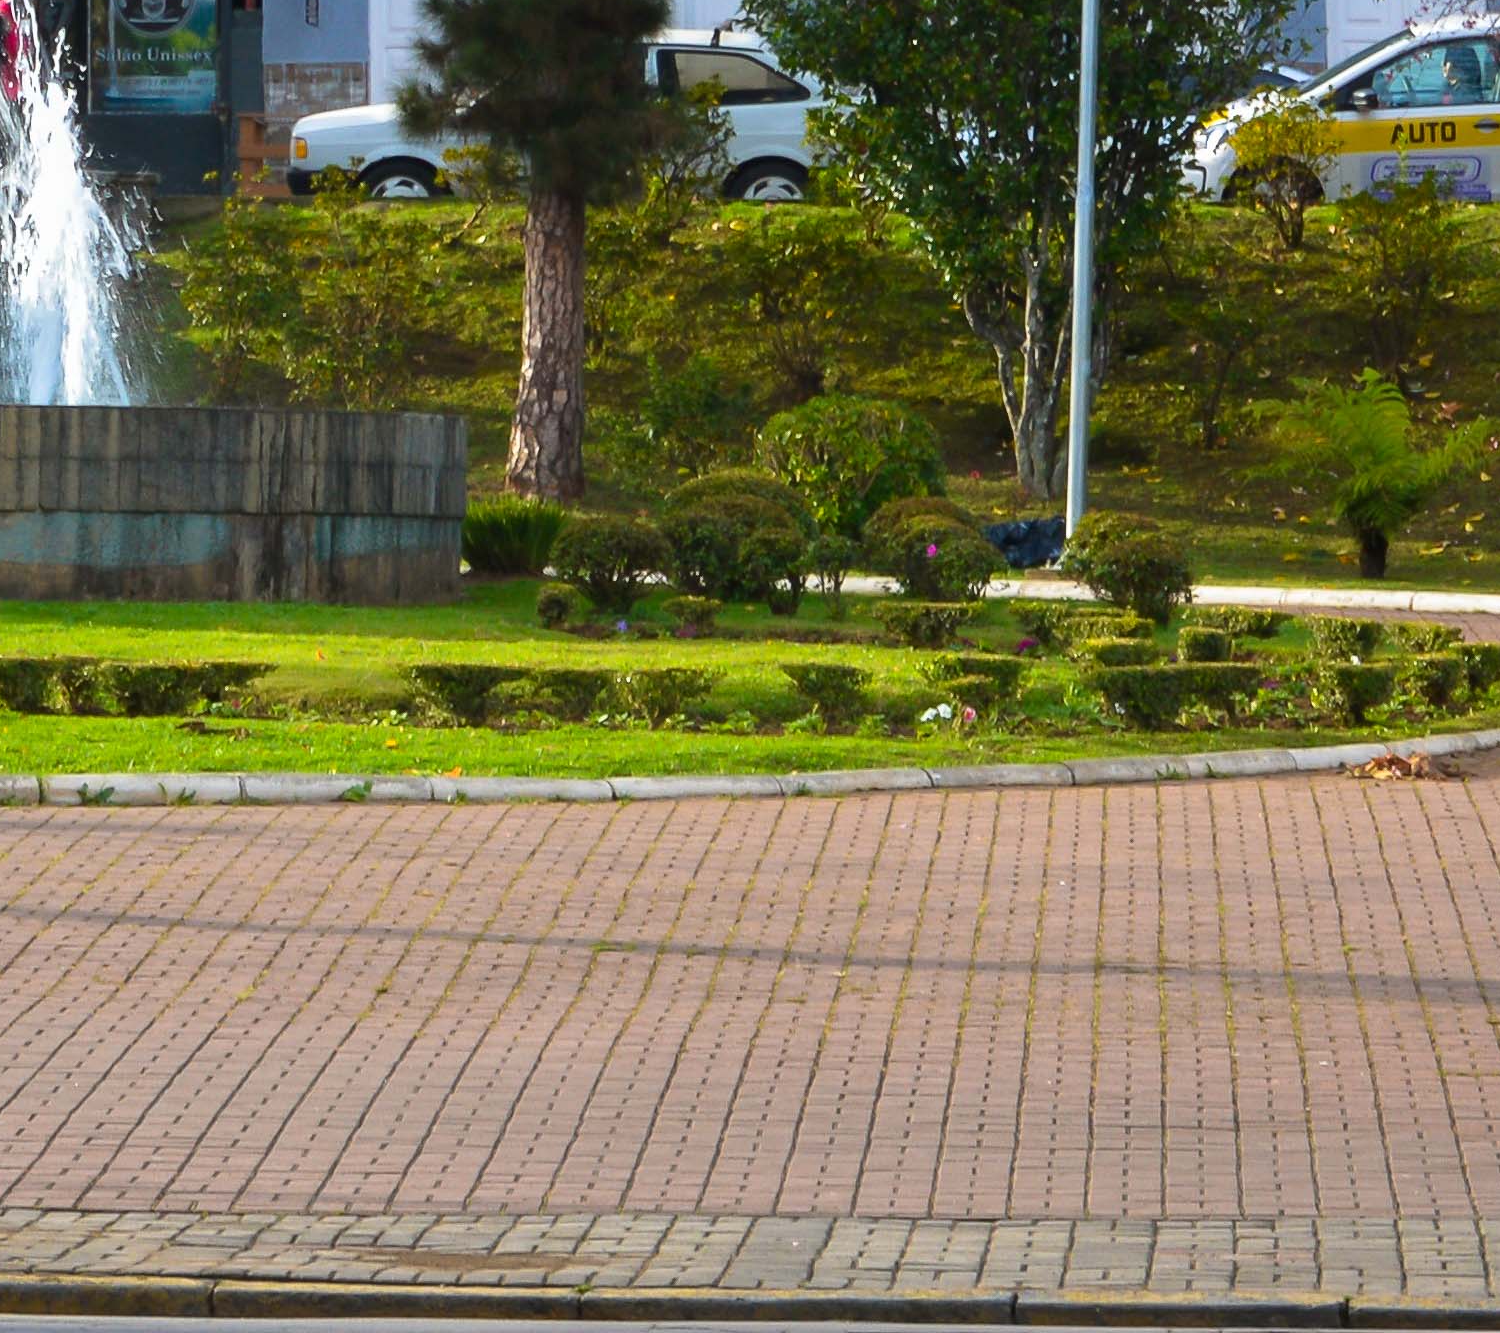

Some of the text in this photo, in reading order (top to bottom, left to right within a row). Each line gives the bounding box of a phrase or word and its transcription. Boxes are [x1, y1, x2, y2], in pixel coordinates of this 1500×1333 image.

[95, 47, 213, 63] Salão Unissex
[1391, 121, 1457, 145] AUTO
